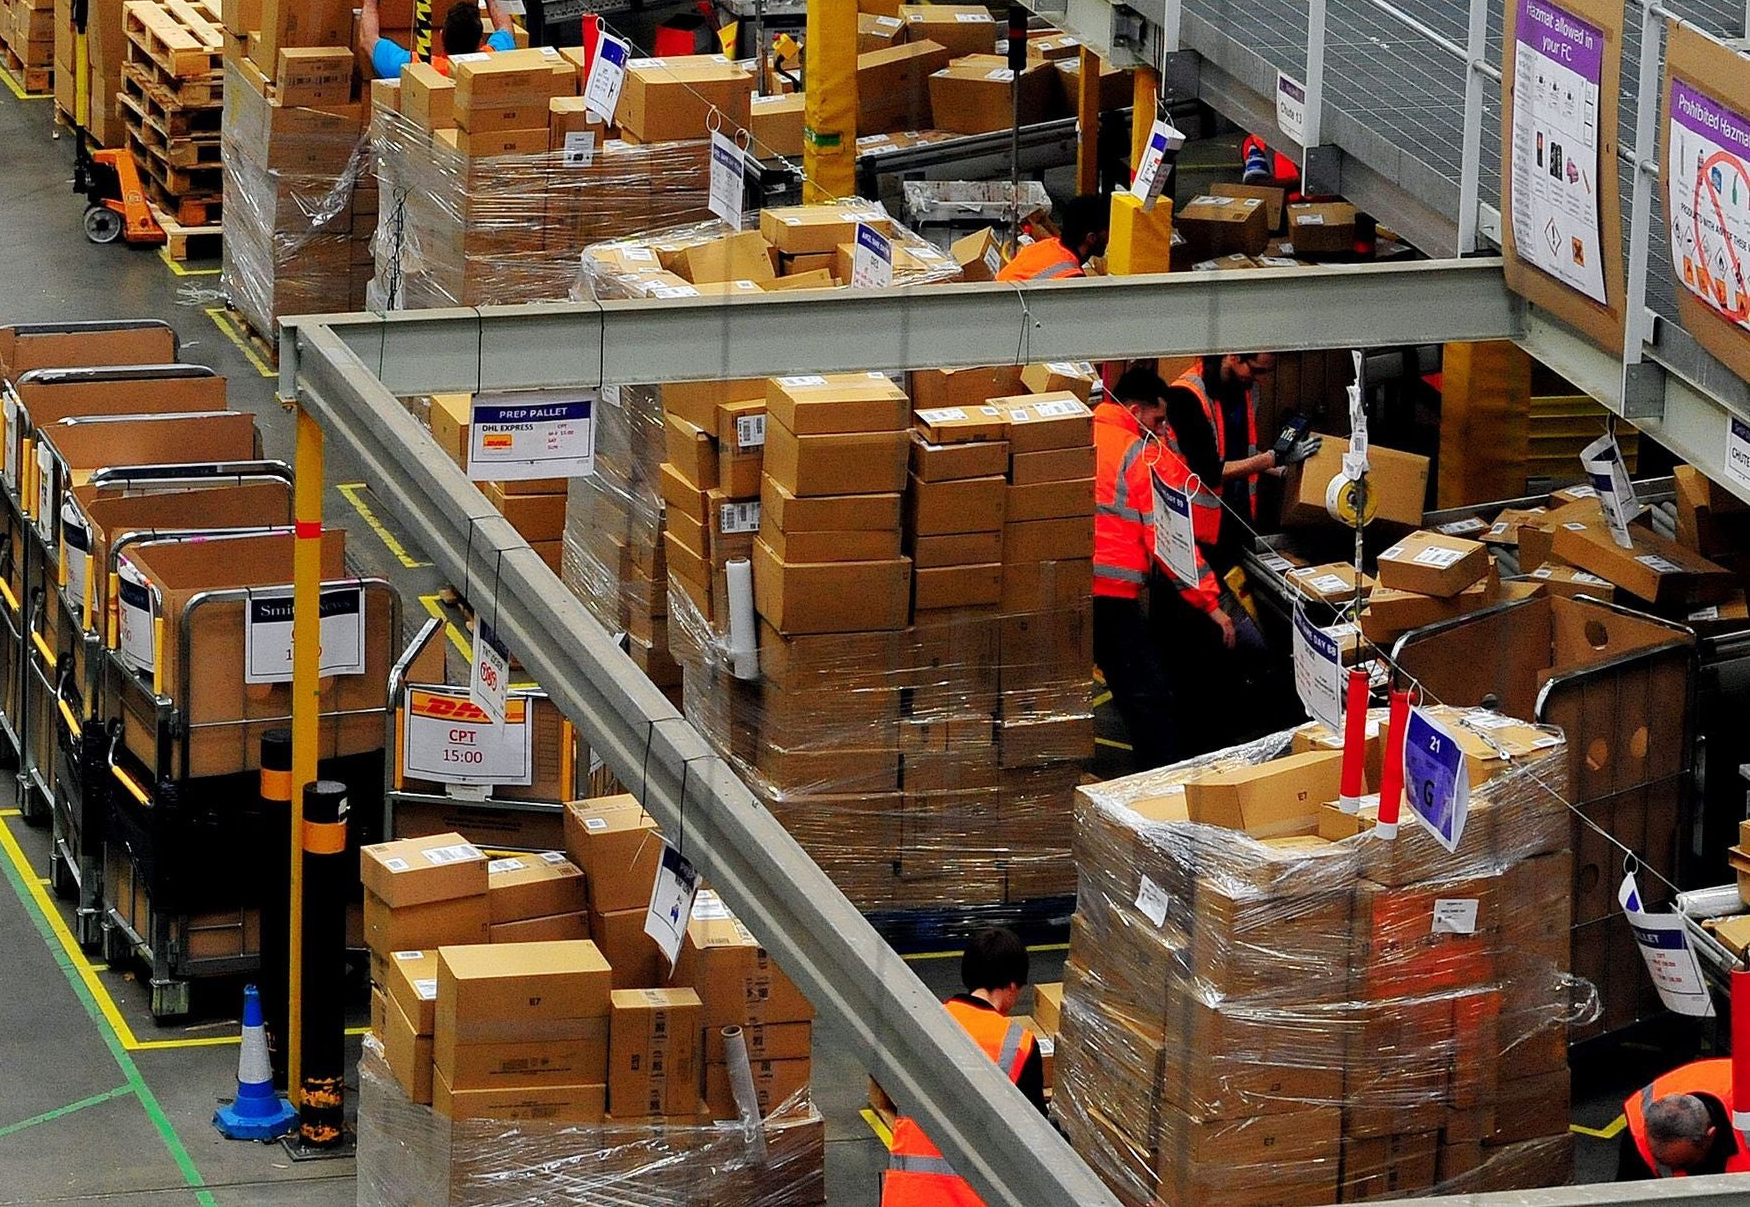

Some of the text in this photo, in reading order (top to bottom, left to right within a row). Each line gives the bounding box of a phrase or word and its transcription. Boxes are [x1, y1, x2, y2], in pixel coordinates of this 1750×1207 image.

[1526, 0, 1594, 50] Hazmat allowed in
[1542, 35, 1573, 62] your FC
[1678, 93, 1720, 130] Prohibited
[499, 407, 568, 419] PREP PALLET
[500, 424, 534, 432] EXPRESS
[1313, 634, 1326, 649] DAY
[449, 729, 476, 743] CPT
[1430, 735, 1441, 754] 21
[443, 749, 483, 764] 15:00
[1423, 779, 1435, 808] G
